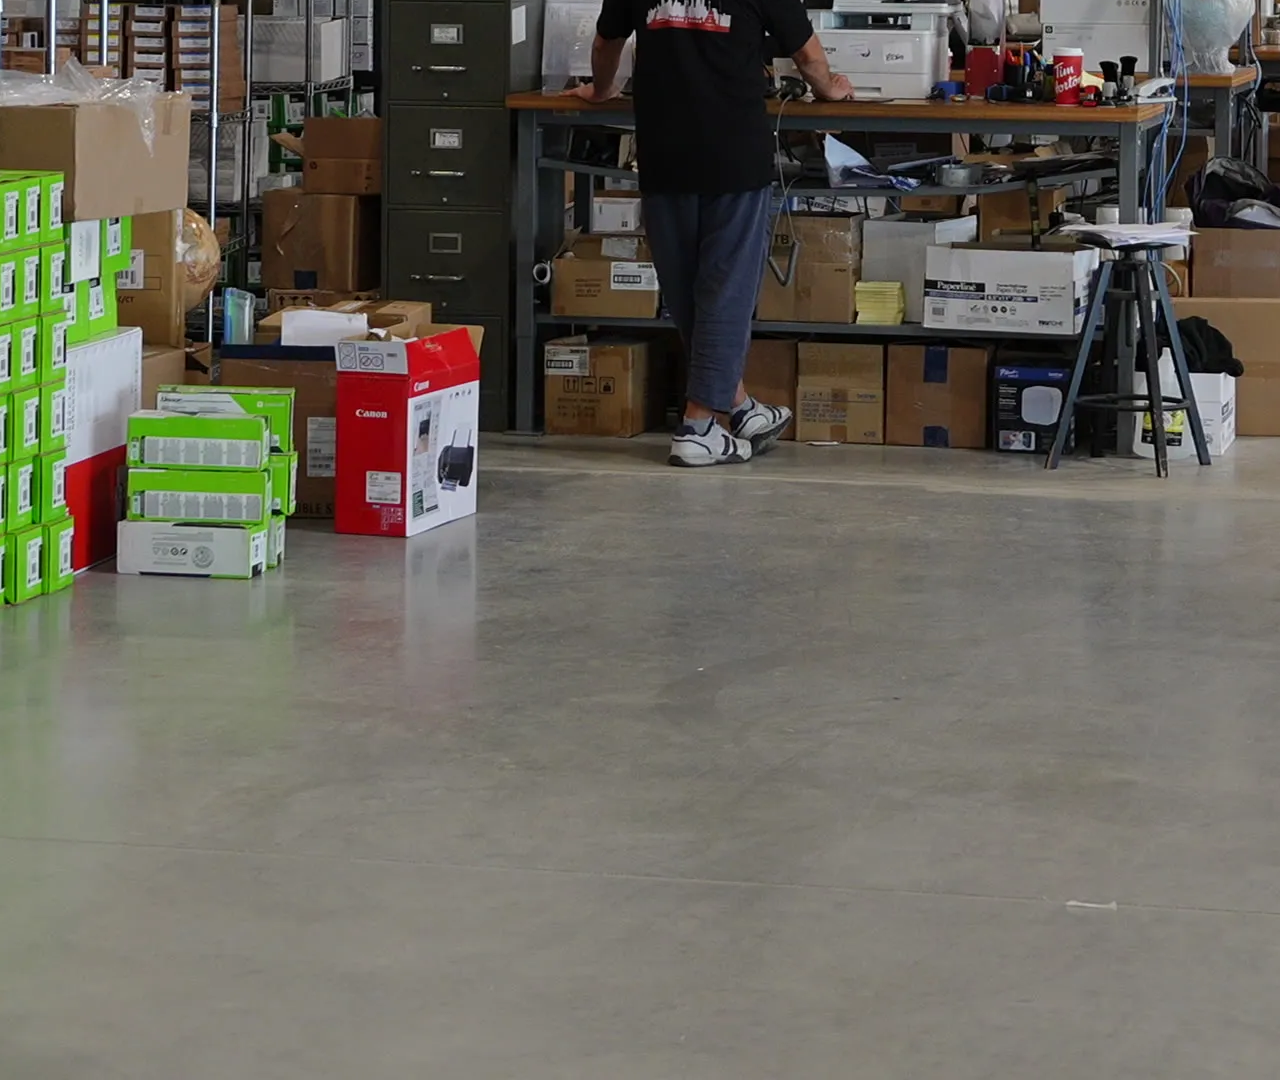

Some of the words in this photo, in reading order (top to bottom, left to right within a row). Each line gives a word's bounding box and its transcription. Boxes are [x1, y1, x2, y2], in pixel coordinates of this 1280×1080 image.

[1053, 62, 1075, 78] Tim
[936, 280, 977, 291] Paperline
[355, 408, 388, 419] Canon
